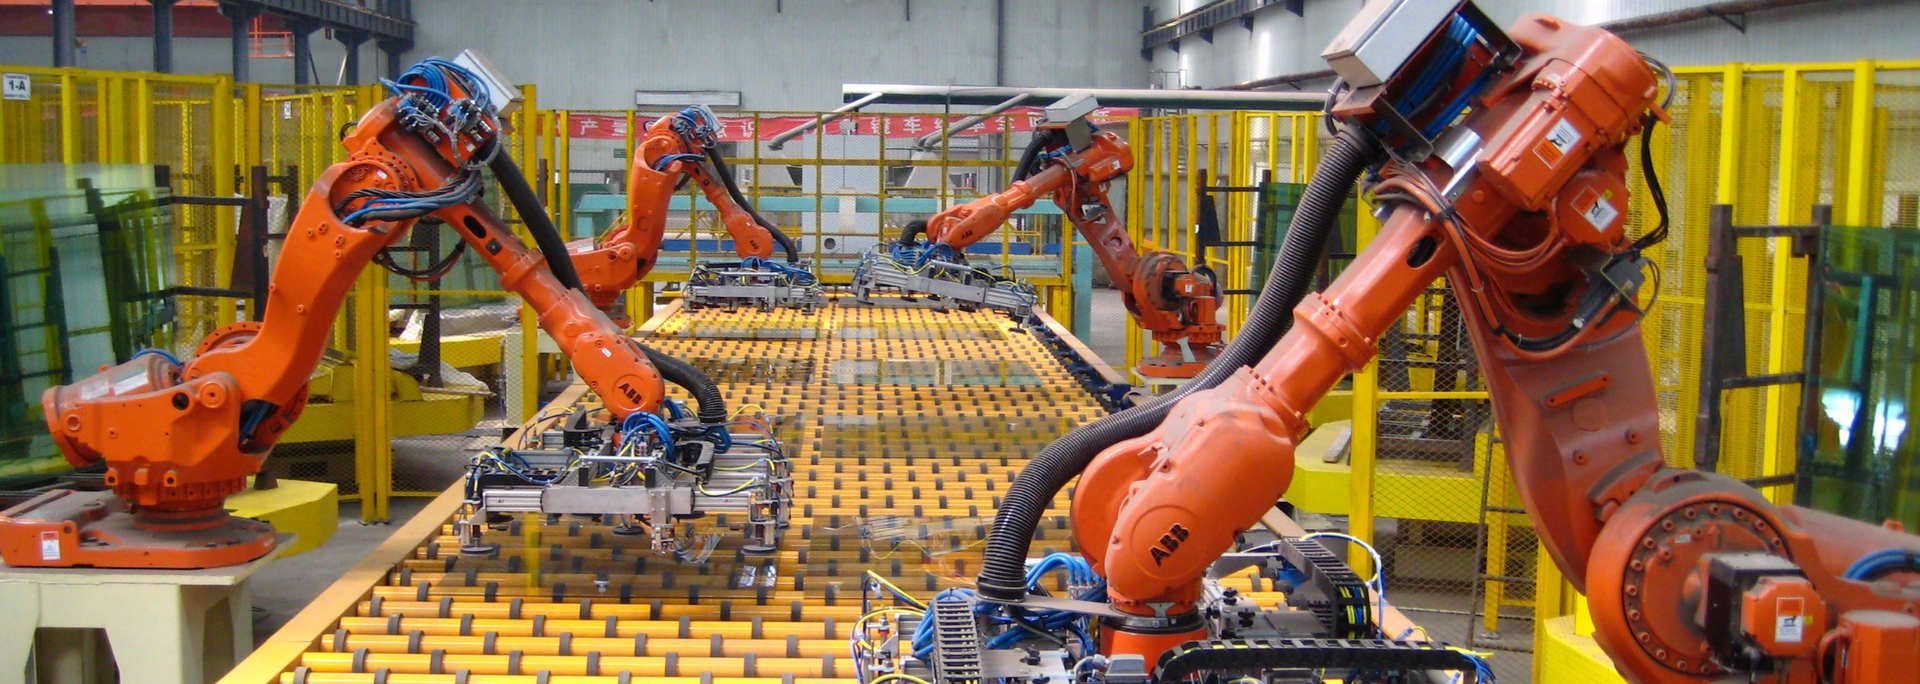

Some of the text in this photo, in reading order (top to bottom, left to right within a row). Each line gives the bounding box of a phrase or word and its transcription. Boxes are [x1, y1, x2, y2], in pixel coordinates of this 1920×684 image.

[8, 79, 26, 91] 1-A
[618, 383, 643, 405] ABB
[1149, 523, 1190, 567] ABB
